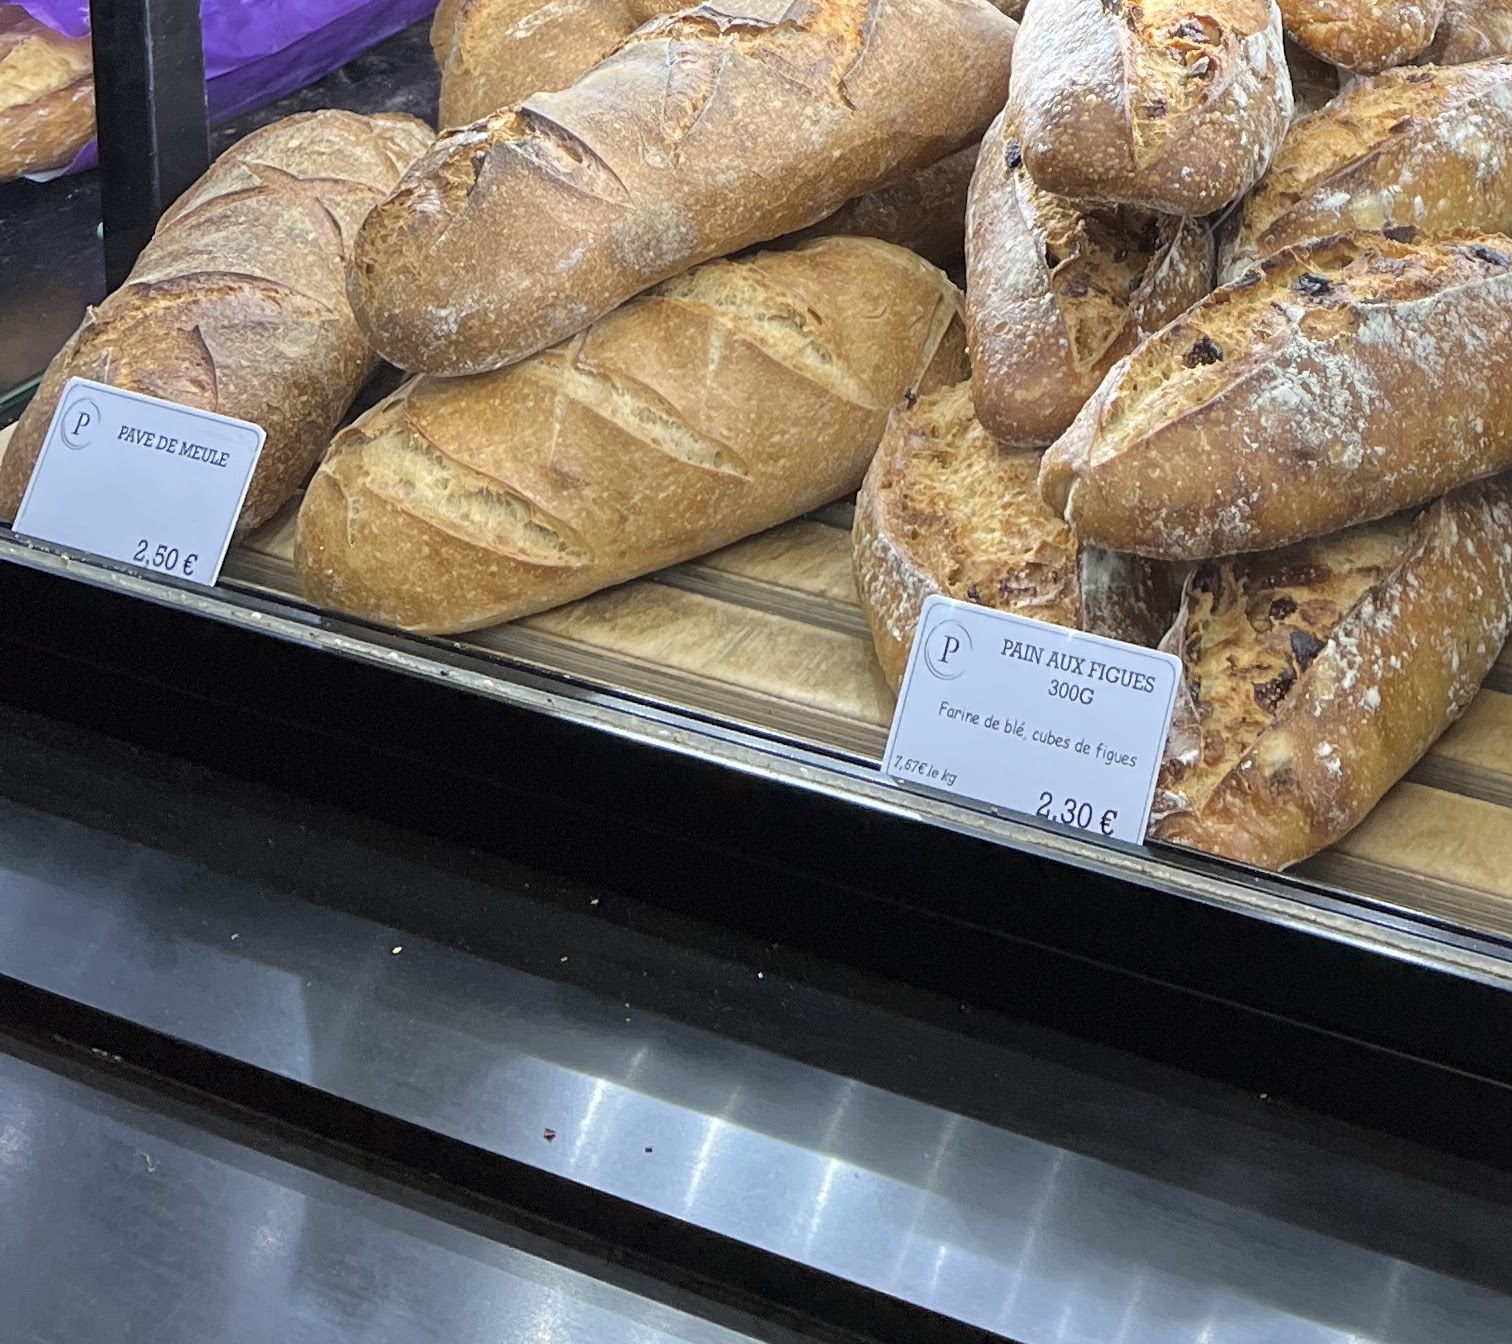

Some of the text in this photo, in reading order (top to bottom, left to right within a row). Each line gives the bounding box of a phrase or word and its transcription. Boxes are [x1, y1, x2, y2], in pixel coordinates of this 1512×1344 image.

[71, 412, 90, 435] P
[117, 425, 230, 468] PAVE DE MEULE
[133, 539, 198, 576] 2,50 €
[938, 635, 960, 663] P
[1000, 639, 1156, 693] PAIN AUX FIGUES
[1048, 679, 1095, 705] 300G
[938, 701, 1137, 768] Farine de blé, cubes de figues
[927, 762, 940, 777] le
[942, 770, 958, 786] kg
[1100, 809, 1118, 836] €
